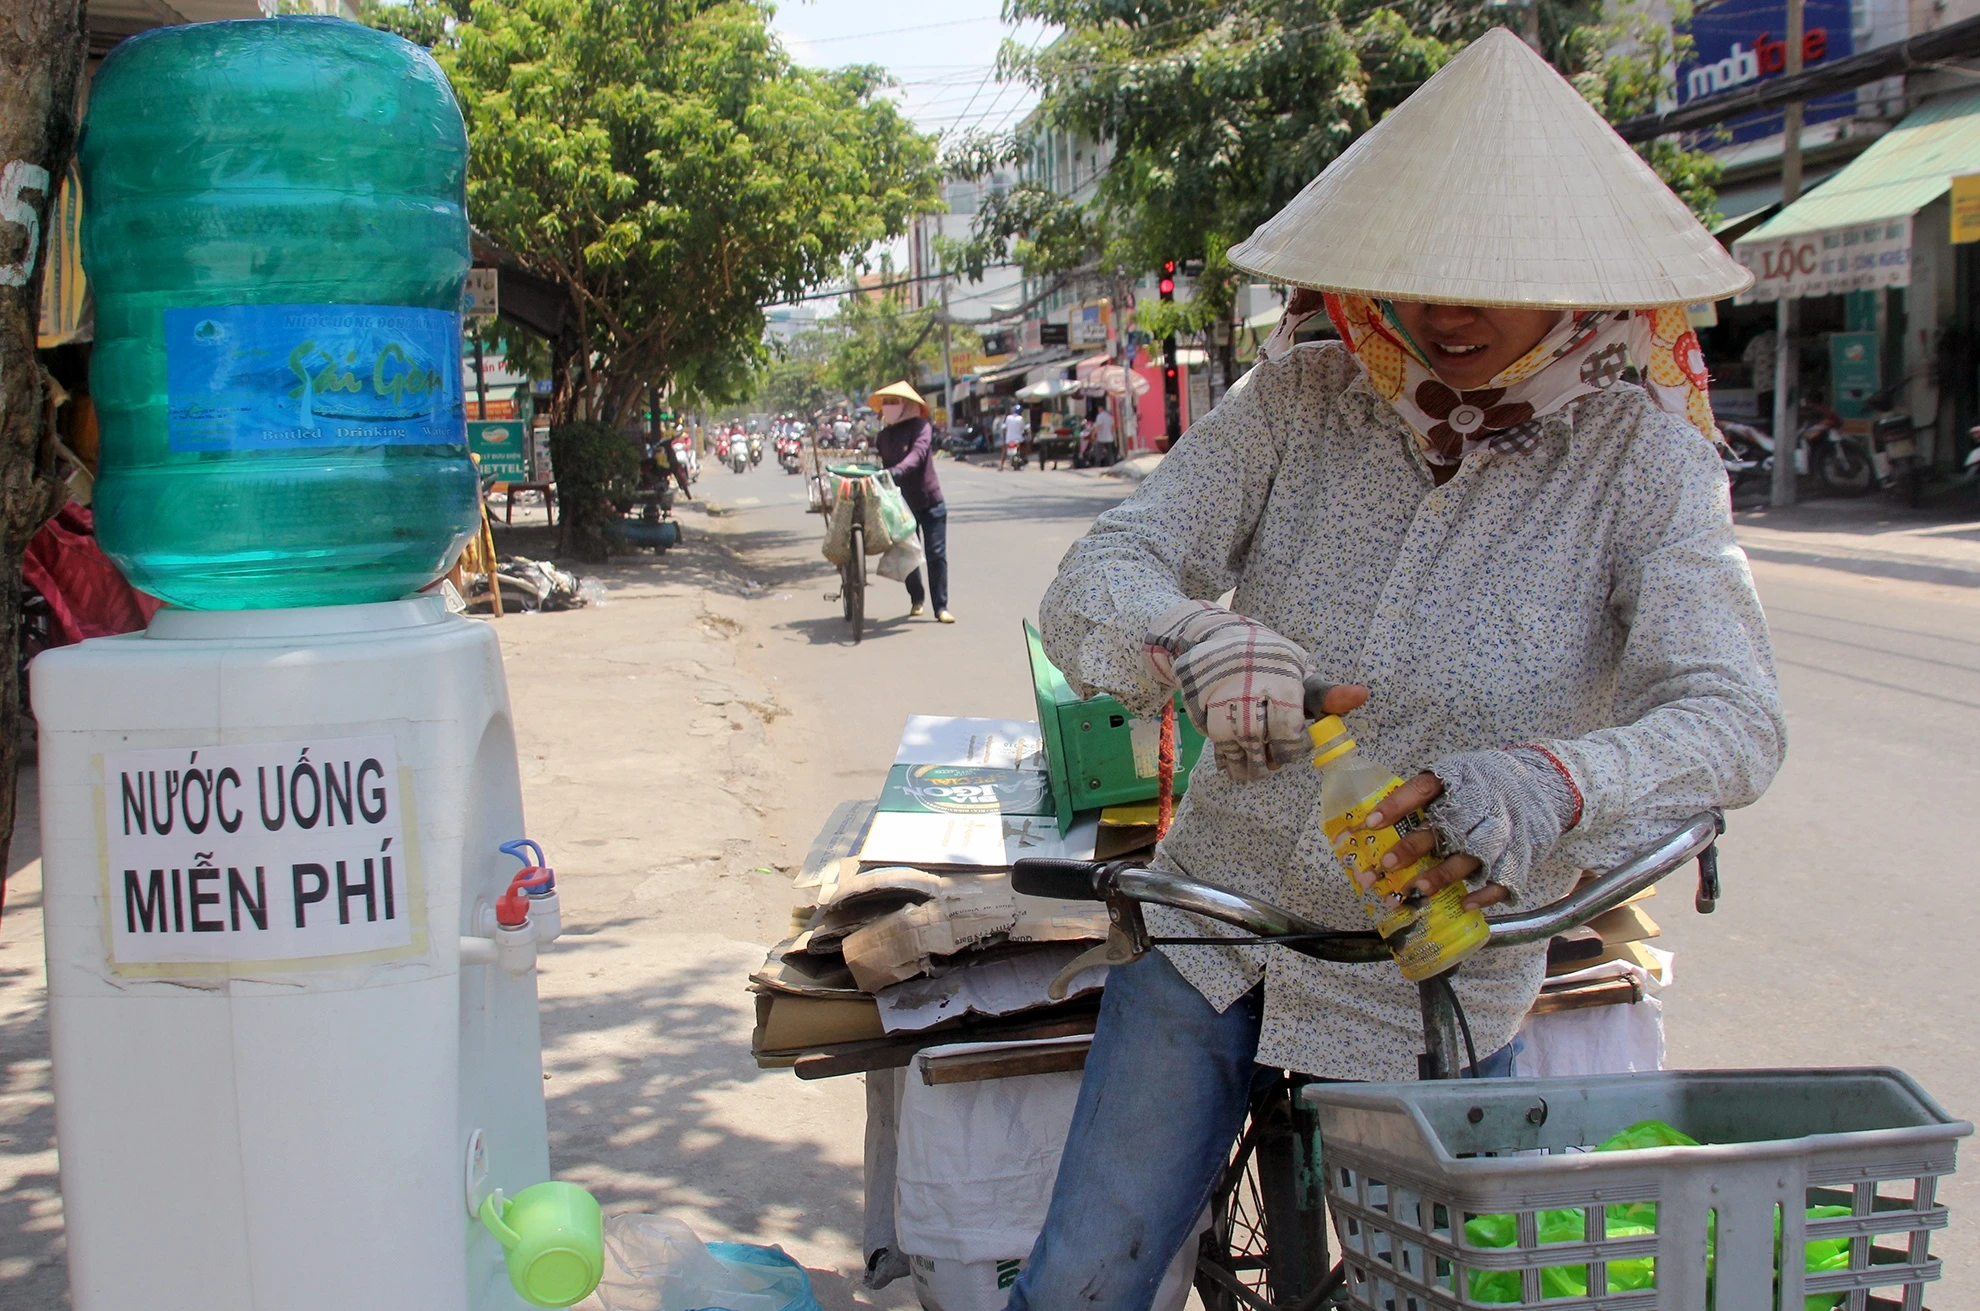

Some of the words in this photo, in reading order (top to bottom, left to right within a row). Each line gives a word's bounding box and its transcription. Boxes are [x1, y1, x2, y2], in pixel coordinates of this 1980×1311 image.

[262, 428, 322, 440] Bottled
[336, 426, 407, 439] Drinking
[422, 426, 451, 436] Water
[480, 463, 523, 474] IETTEL
[121, 750, 243, 836] NƯỚC
[258, 747, 388, 832] UỐNG
[124, 851, 269, 933] MIỄN
[292, 837, 396, 929] PHÍ
